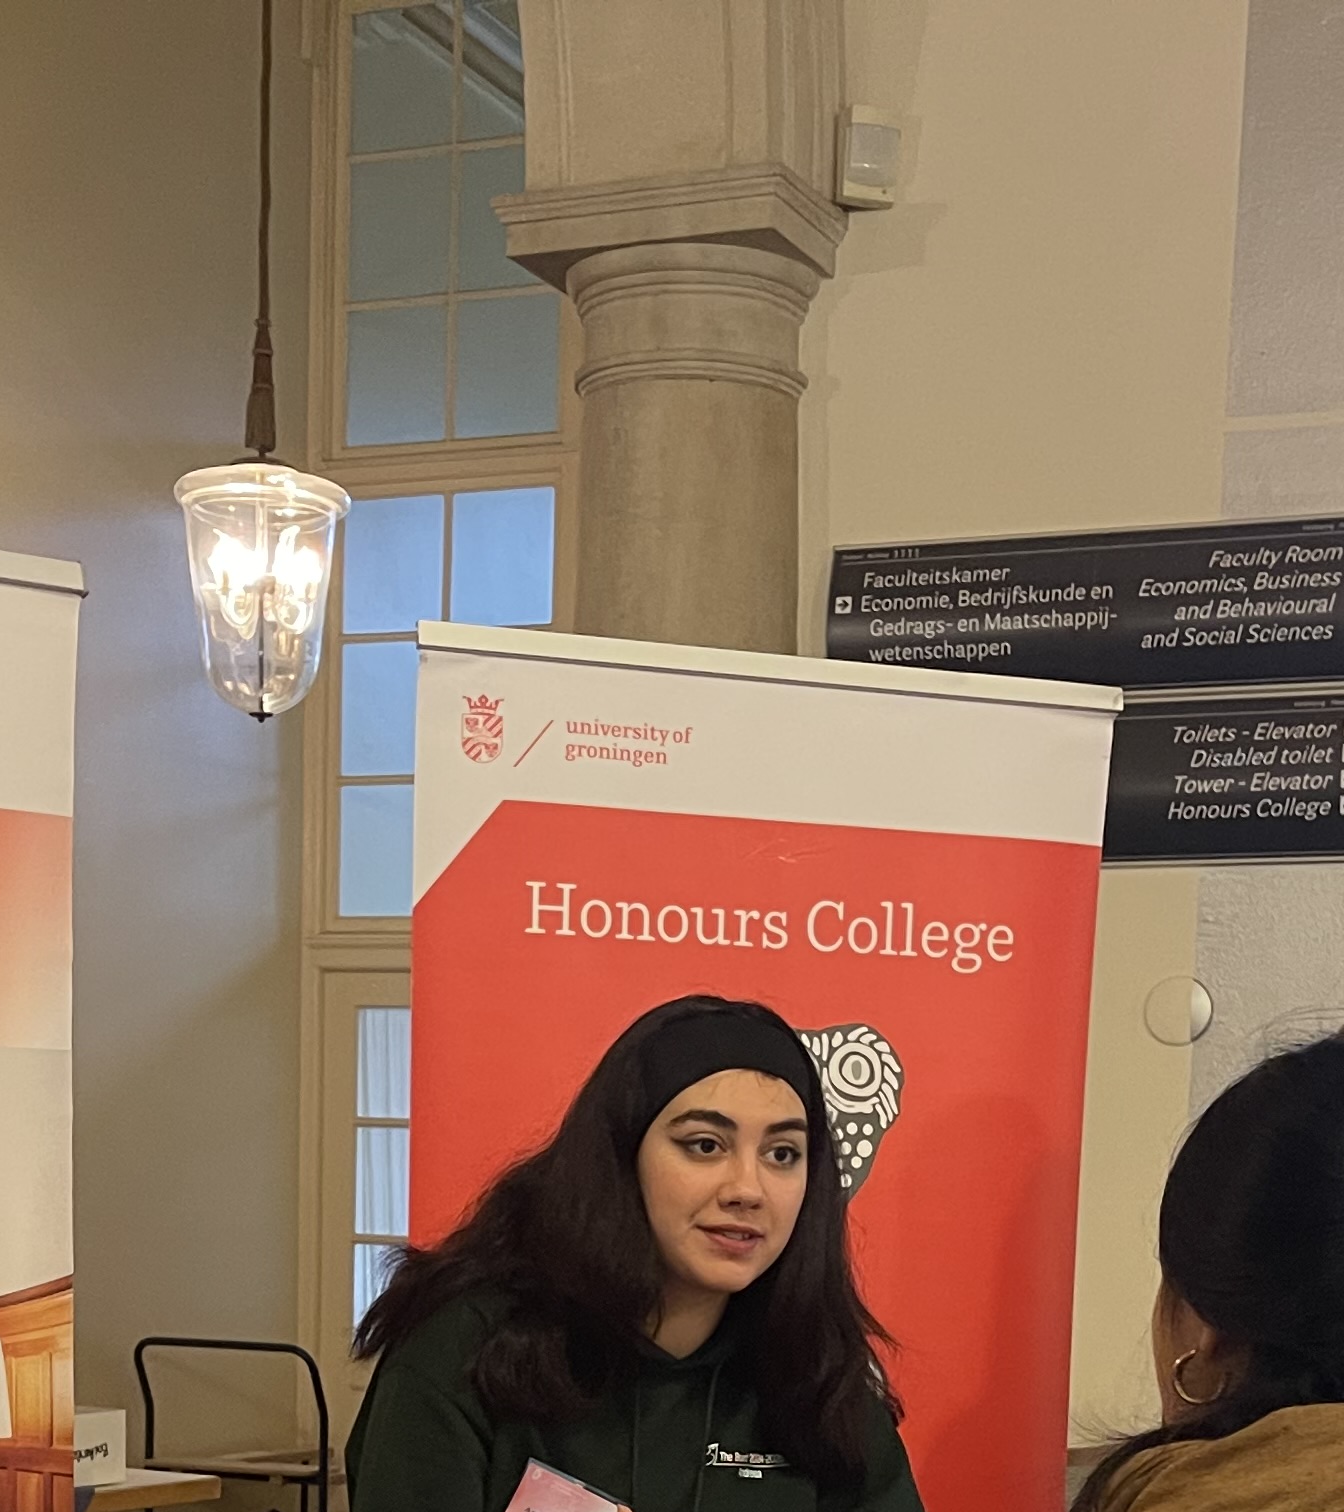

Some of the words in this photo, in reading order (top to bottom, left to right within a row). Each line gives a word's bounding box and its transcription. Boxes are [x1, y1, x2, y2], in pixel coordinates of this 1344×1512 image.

[1209, 547, 1282, 569] Faculty
[1285, 545, 1344, 563] Room
[863, 567, 1011, 588] Faculteitskamer
[1139, 574, 1248, 597] Economics,
[1254, 571, 1342, 591] Business
[860, 592, 954, 613] Economie,
[958, 583, 1086, 608] Bedrijfskunde
[1090, 584, 1113, 599] en
[1174, 600, 1213, 620] and
[1216, 593, 1336, 619] Behavioural
[870, 619, 953, 638] Gedrags-
[957, 616, 980, 632] en
[985, 606, 1118, 631] Maatschappij-
[1141, 628, 1179, 649] and
[1182, 624, 1243, 647] Social
[1246, 623, 1334, 643] Sciences
[869, 640, 1011, 662] wetenschappen
[566, 719, 669, 746] university
[673, 727, 693, 743] of
[1173, 725, 1237, 744] Toilets
[1253, 722, 1337, 741] Elevator
[565, 743, 666, 767] groningen
[1190, 746, 1277, 768] Disabled
[1281, 745, 1334, 765] toilet
[1174, 775, 1234, 794] Tower
[1250, 771, 1333, 792] Elevator
[1168, 802, 1251, 820] Honours
[1256, 797, 1332, 821] College
[525, 881, 788, 949] Honours
[808, 901, 1013, 973] College
